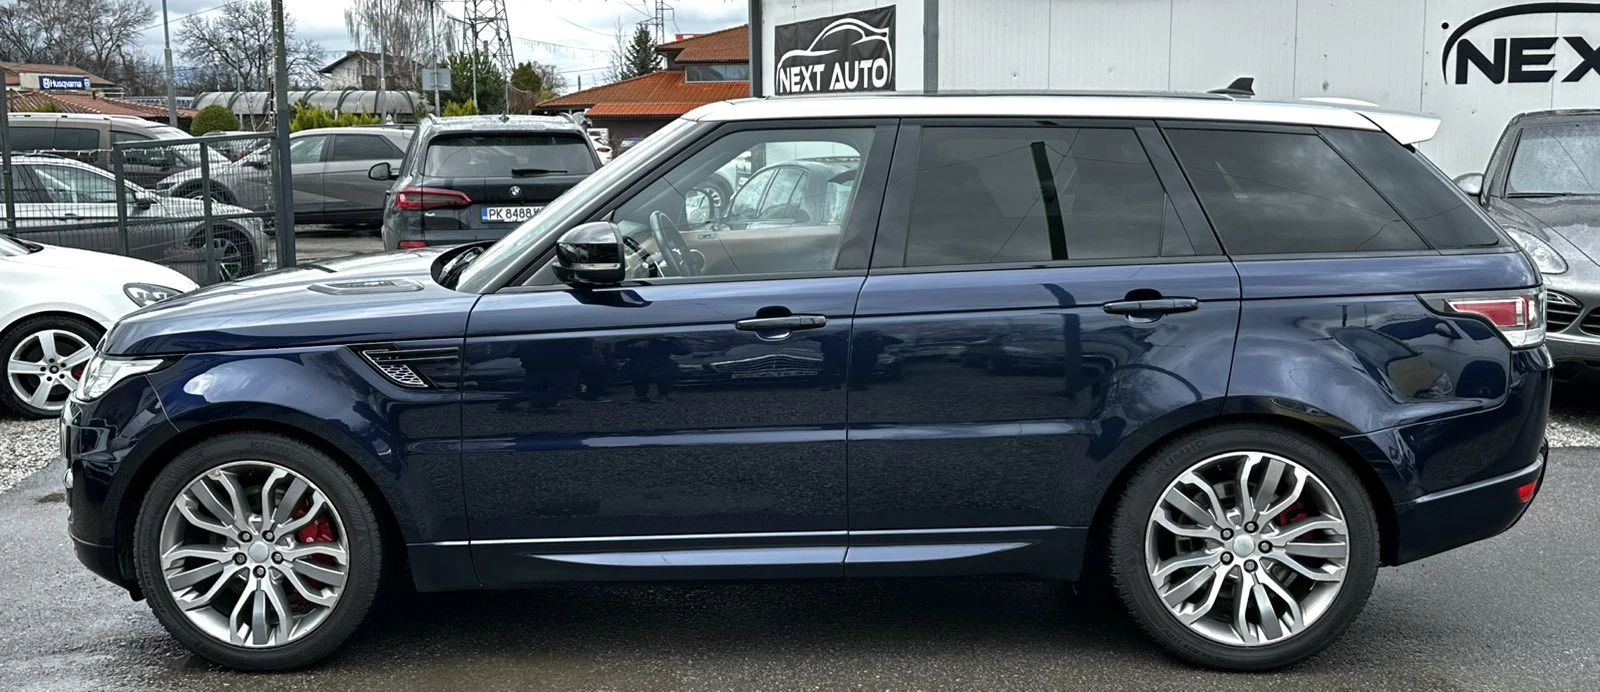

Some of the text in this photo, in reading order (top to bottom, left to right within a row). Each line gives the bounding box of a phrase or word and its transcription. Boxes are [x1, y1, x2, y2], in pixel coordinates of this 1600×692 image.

[50, 79, 82, 88] Husqvarna
[779, 58, 888, 93] NEXT AUTO
[489, 208, 503, 219] PK
[505, 208, 532, 219] 8488
[1153, 440, 1206, 475] KUMHO
